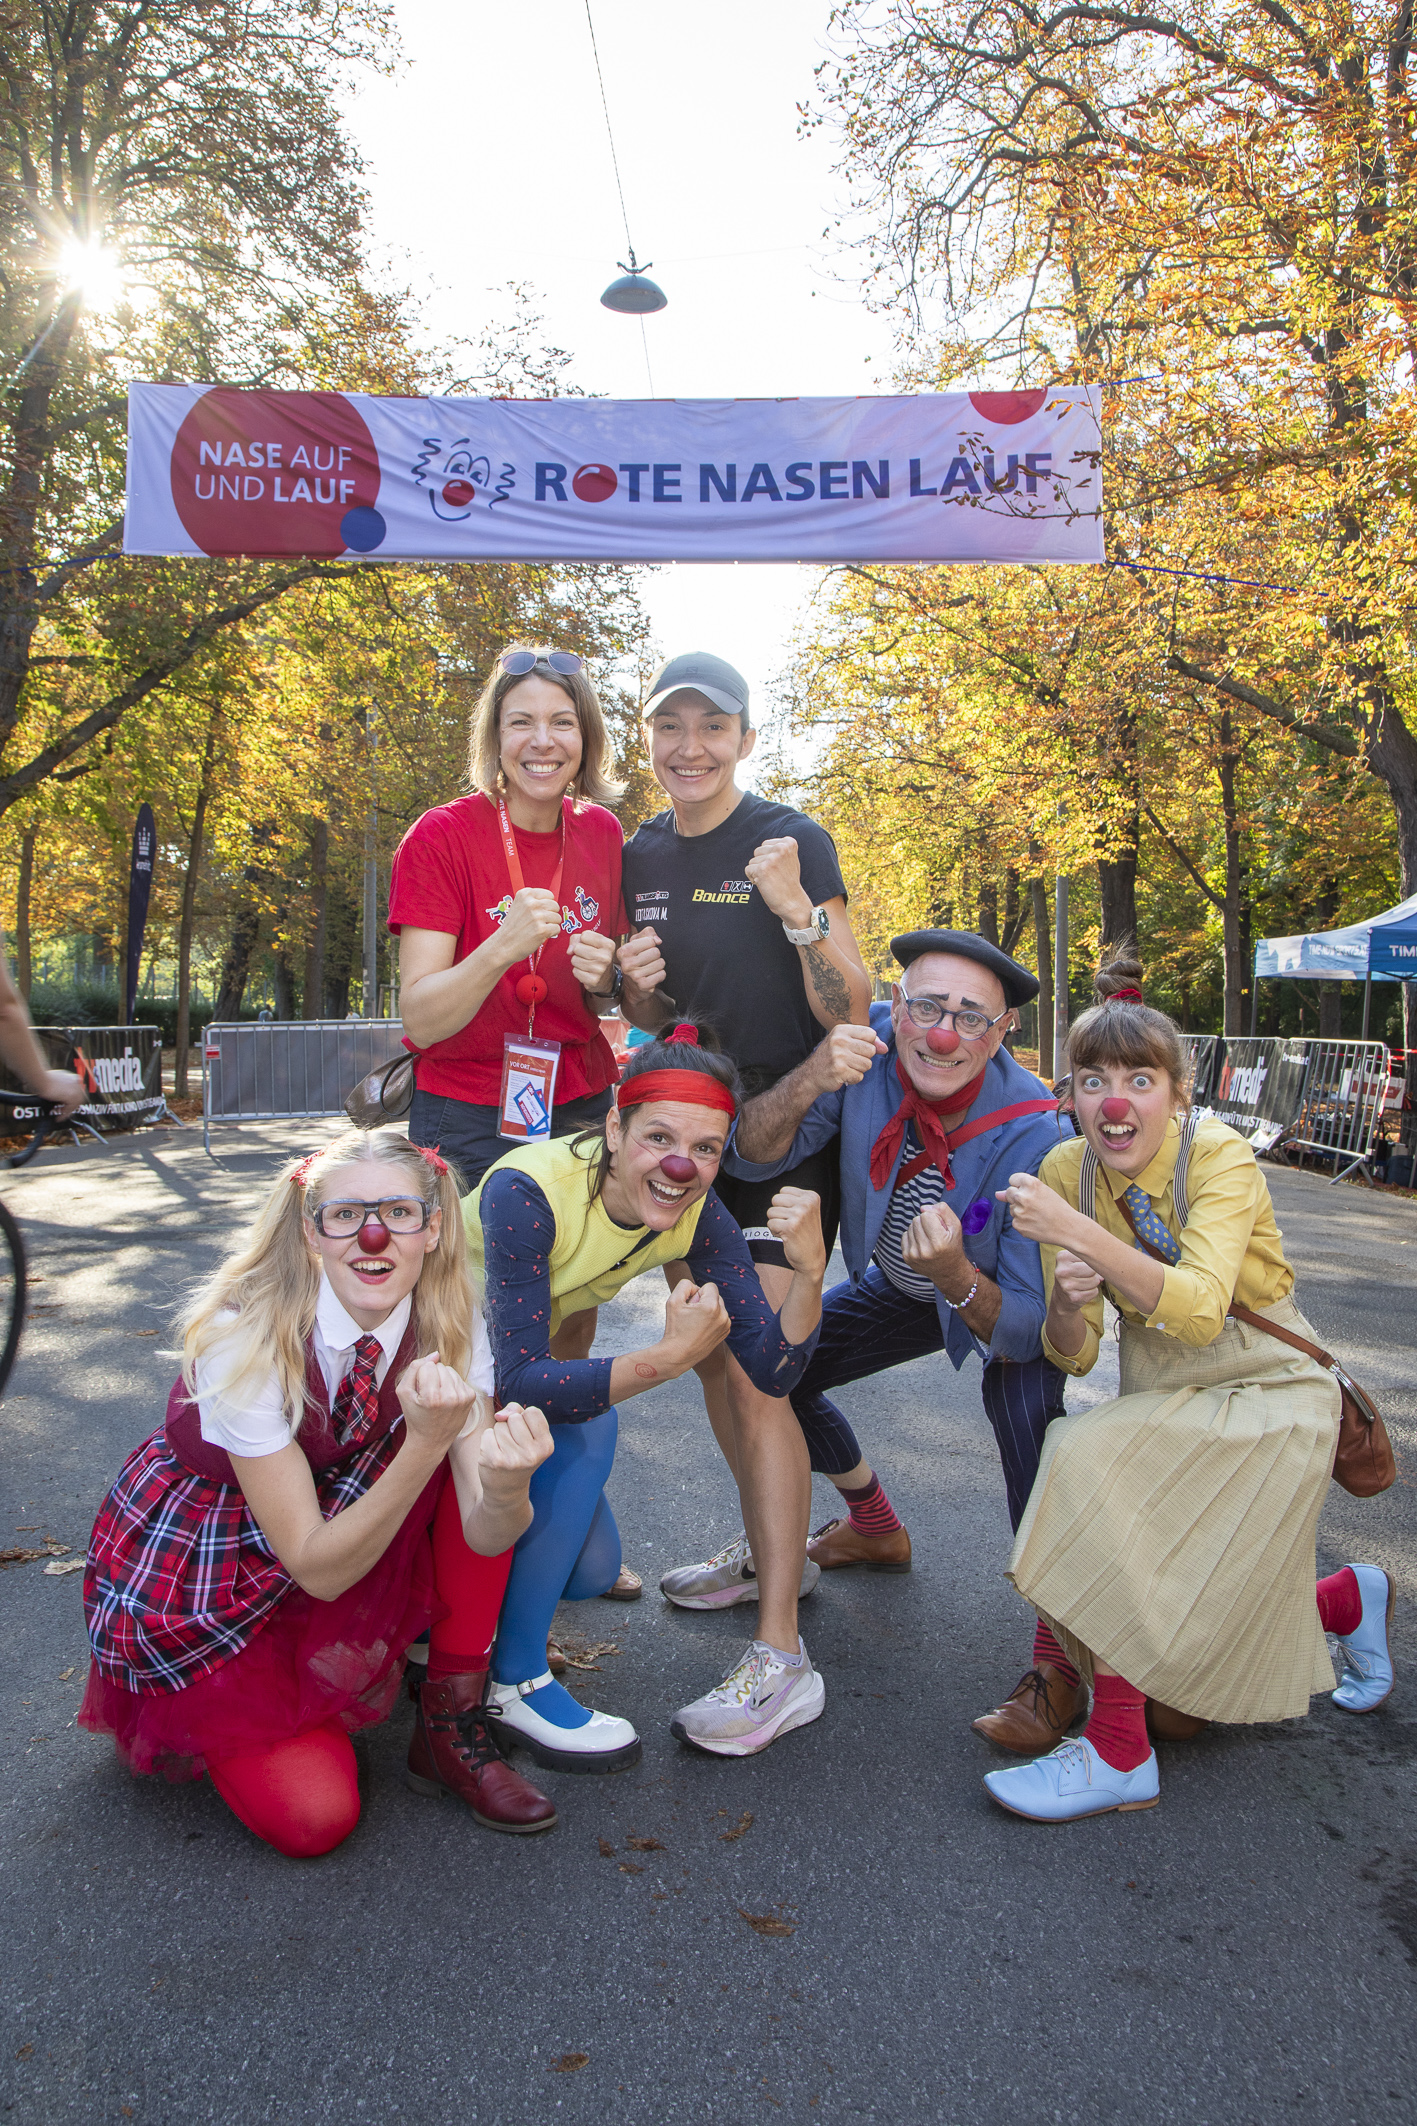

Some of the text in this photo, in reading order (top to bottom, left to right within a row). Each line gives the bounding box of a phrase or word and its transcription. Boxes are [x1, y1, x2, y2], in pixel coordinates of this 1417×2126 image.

[199, 441, 353, 472] NASE AUF
[194, 474, 356, 504] UND LAUF
[535, 453, 1052, 503] ROTE NASEN LAUF
[500, 811, 510, 833] NASEN
[506, 838, 515, 857] TEAM
[692, 889, 750, 904] Bounce
[1389, 945, 1417, 957] TIM
